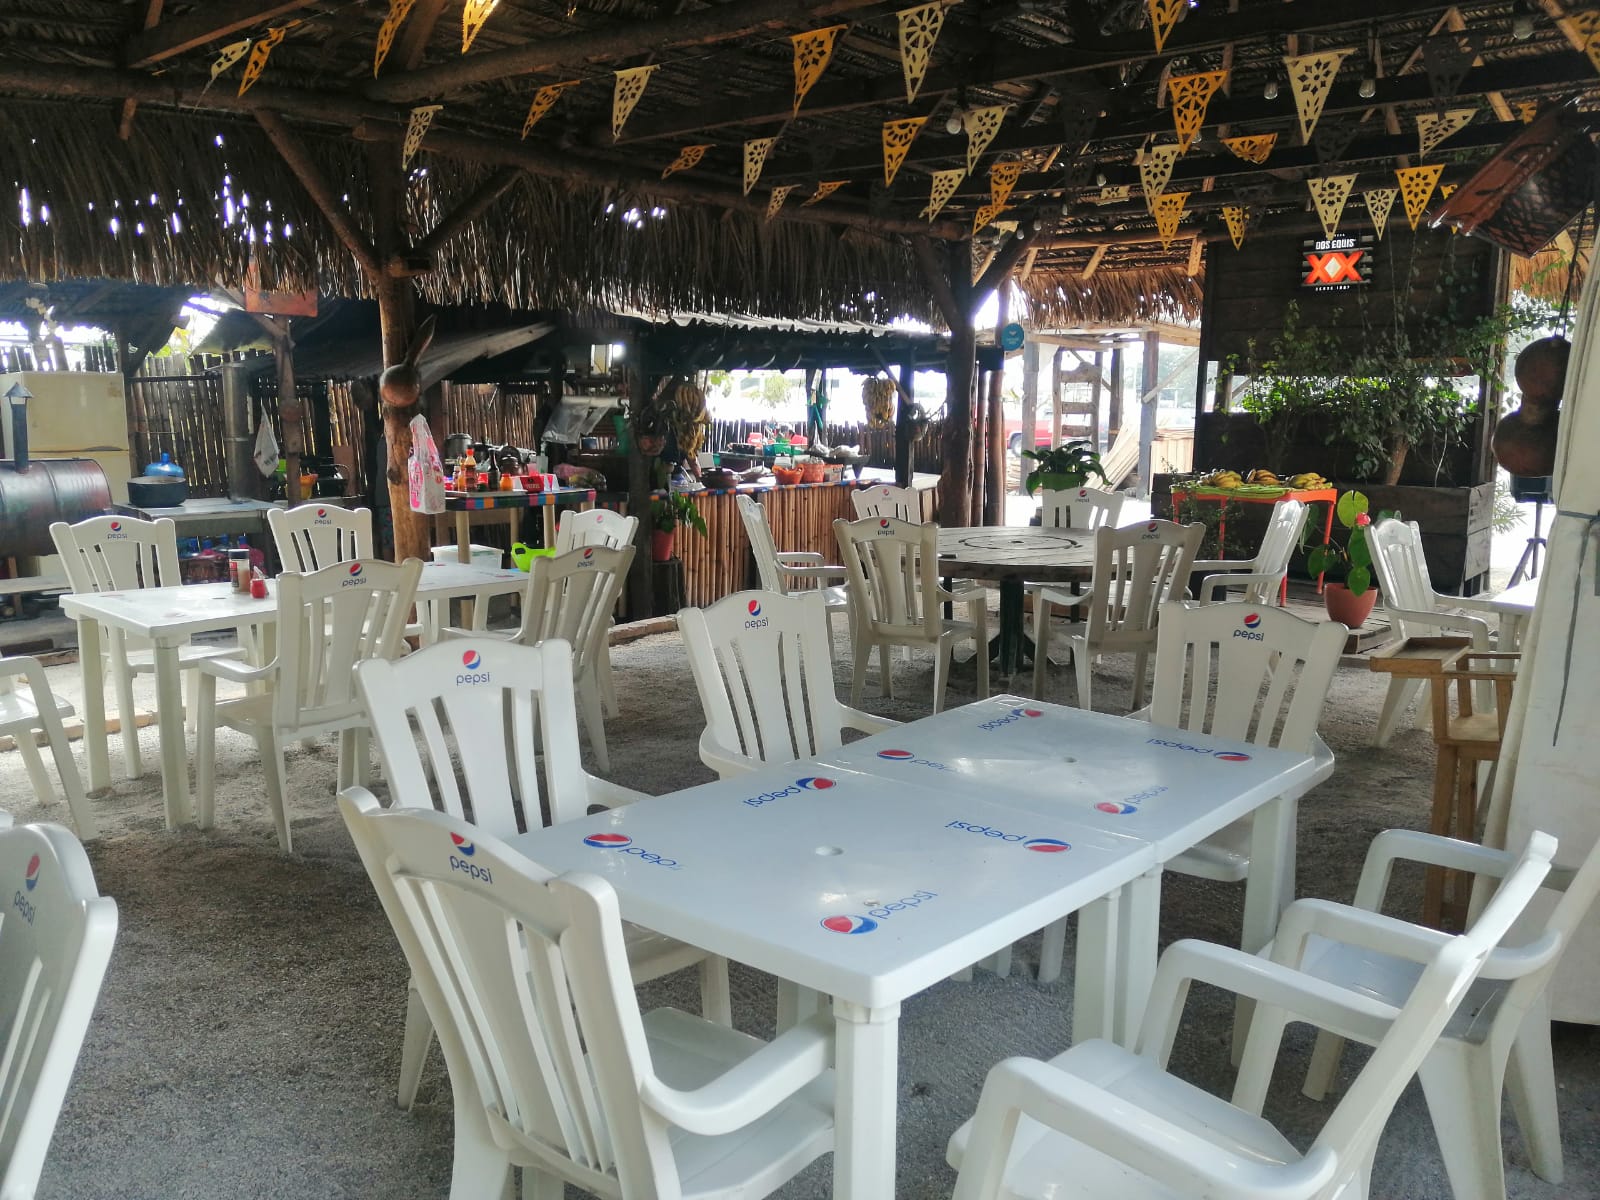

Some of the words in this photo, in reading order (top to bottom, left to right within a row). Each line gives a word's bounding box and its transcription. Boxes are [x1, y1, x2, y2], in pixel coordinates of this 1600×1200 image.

[1315, 240, 1330, 250] DOS
[1331, 239, 1355, 249] EQUIS
[342, 578, 367, 587] pepsi
[744, 617, 769, 629] pepsi
[1233, 629, 1265, 641] pepsi
[456, 671, 490, 686] pepsi
[1146, 738, 1214, 754] pepsi
[743, 785, 801, 807] pepsi
[944, 820, 1026, 843] pepsi
[450, 855, 493, 884] pepsi
[14, 890, 36, 923] pepsi
[866, 890, 938, 920] pepsi
